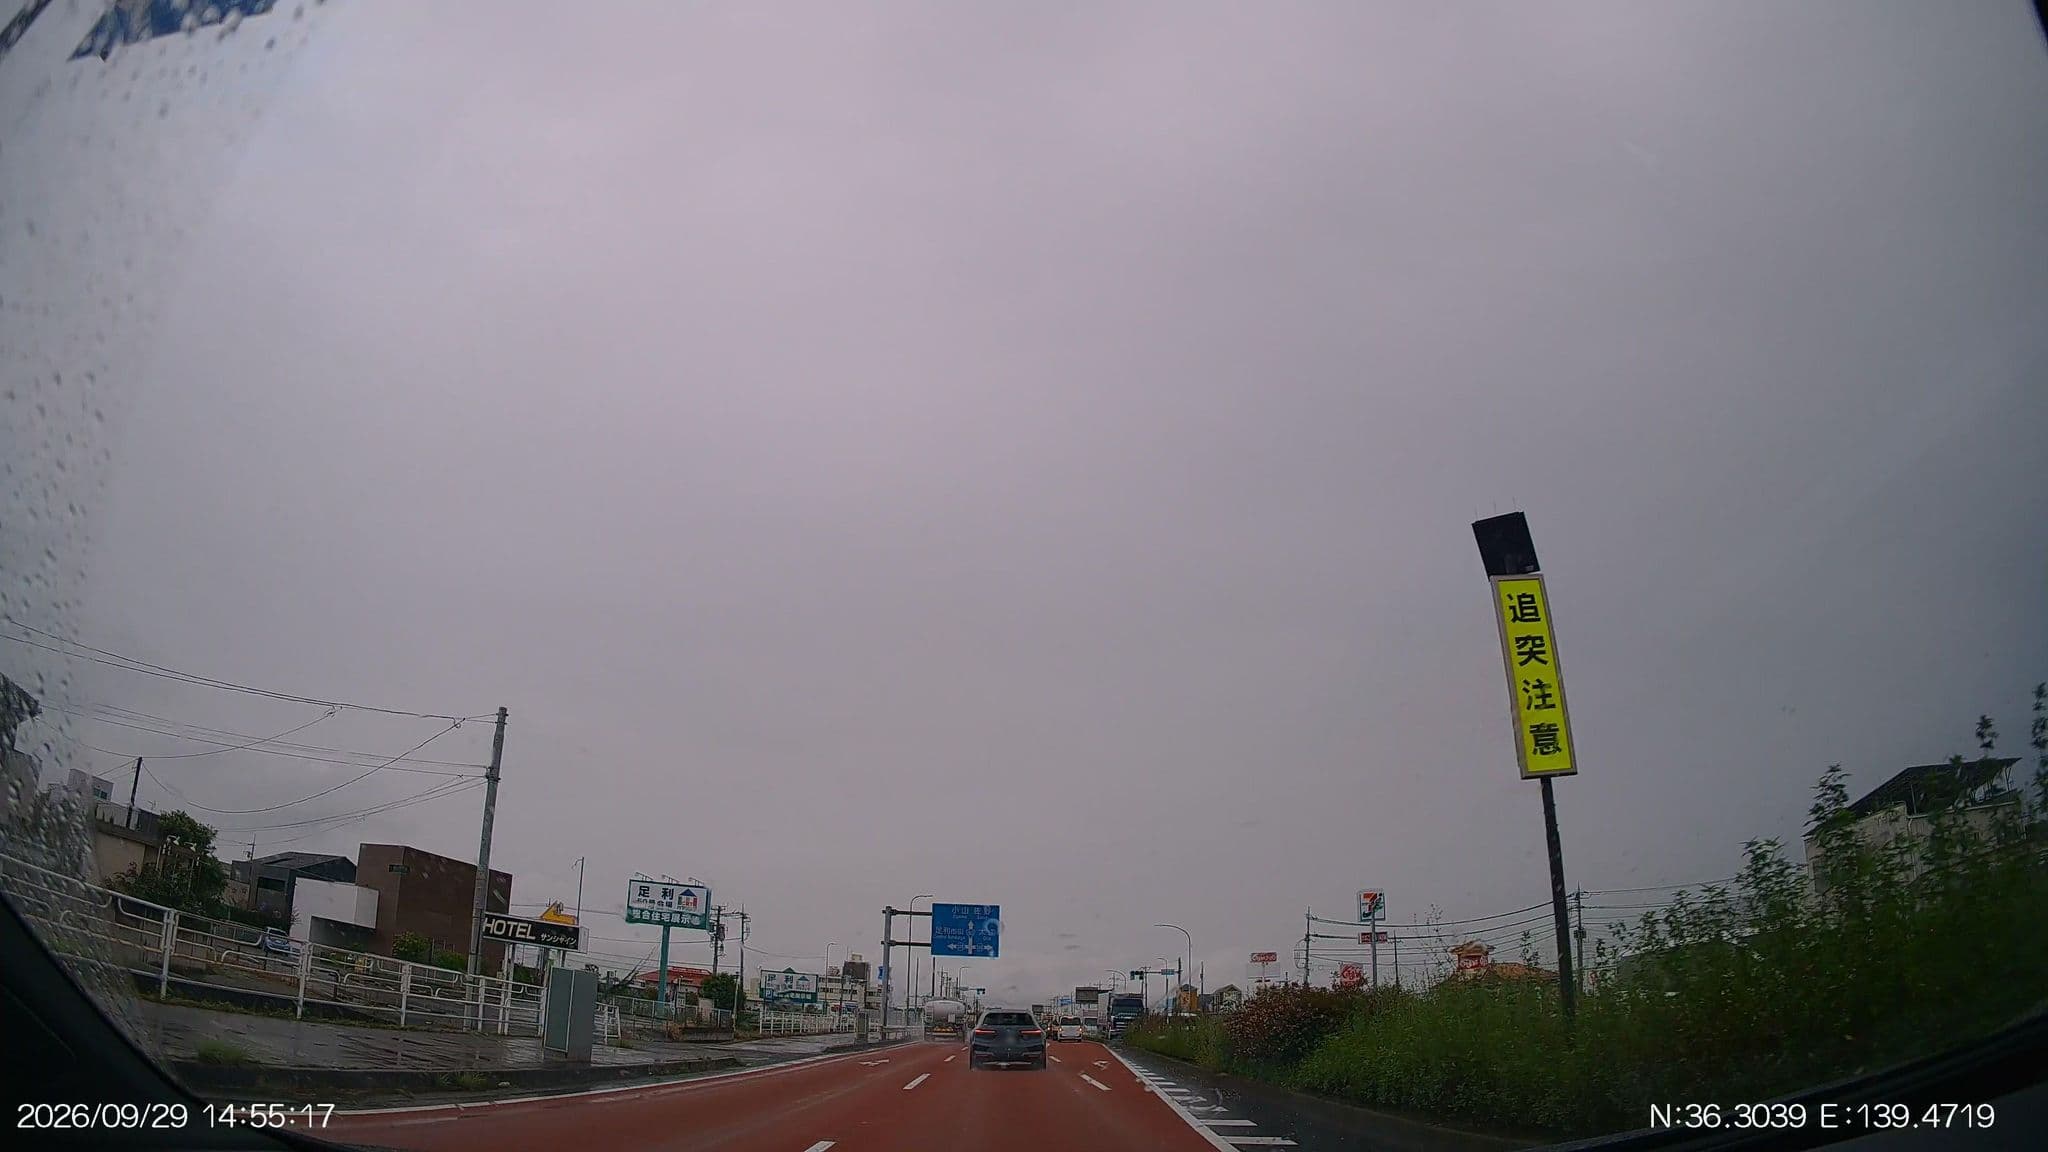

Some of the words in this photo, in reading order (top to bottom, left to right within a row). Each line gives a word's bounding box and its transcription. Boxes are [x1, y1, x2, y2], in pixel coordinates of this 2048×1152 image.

[1507, 592, 1562, 756] 追突注意
[638, 886, 675, 900] 足利
[482, 917, 536, 940] HOTEL
[541, 932, 577, 945] サンシャイン
